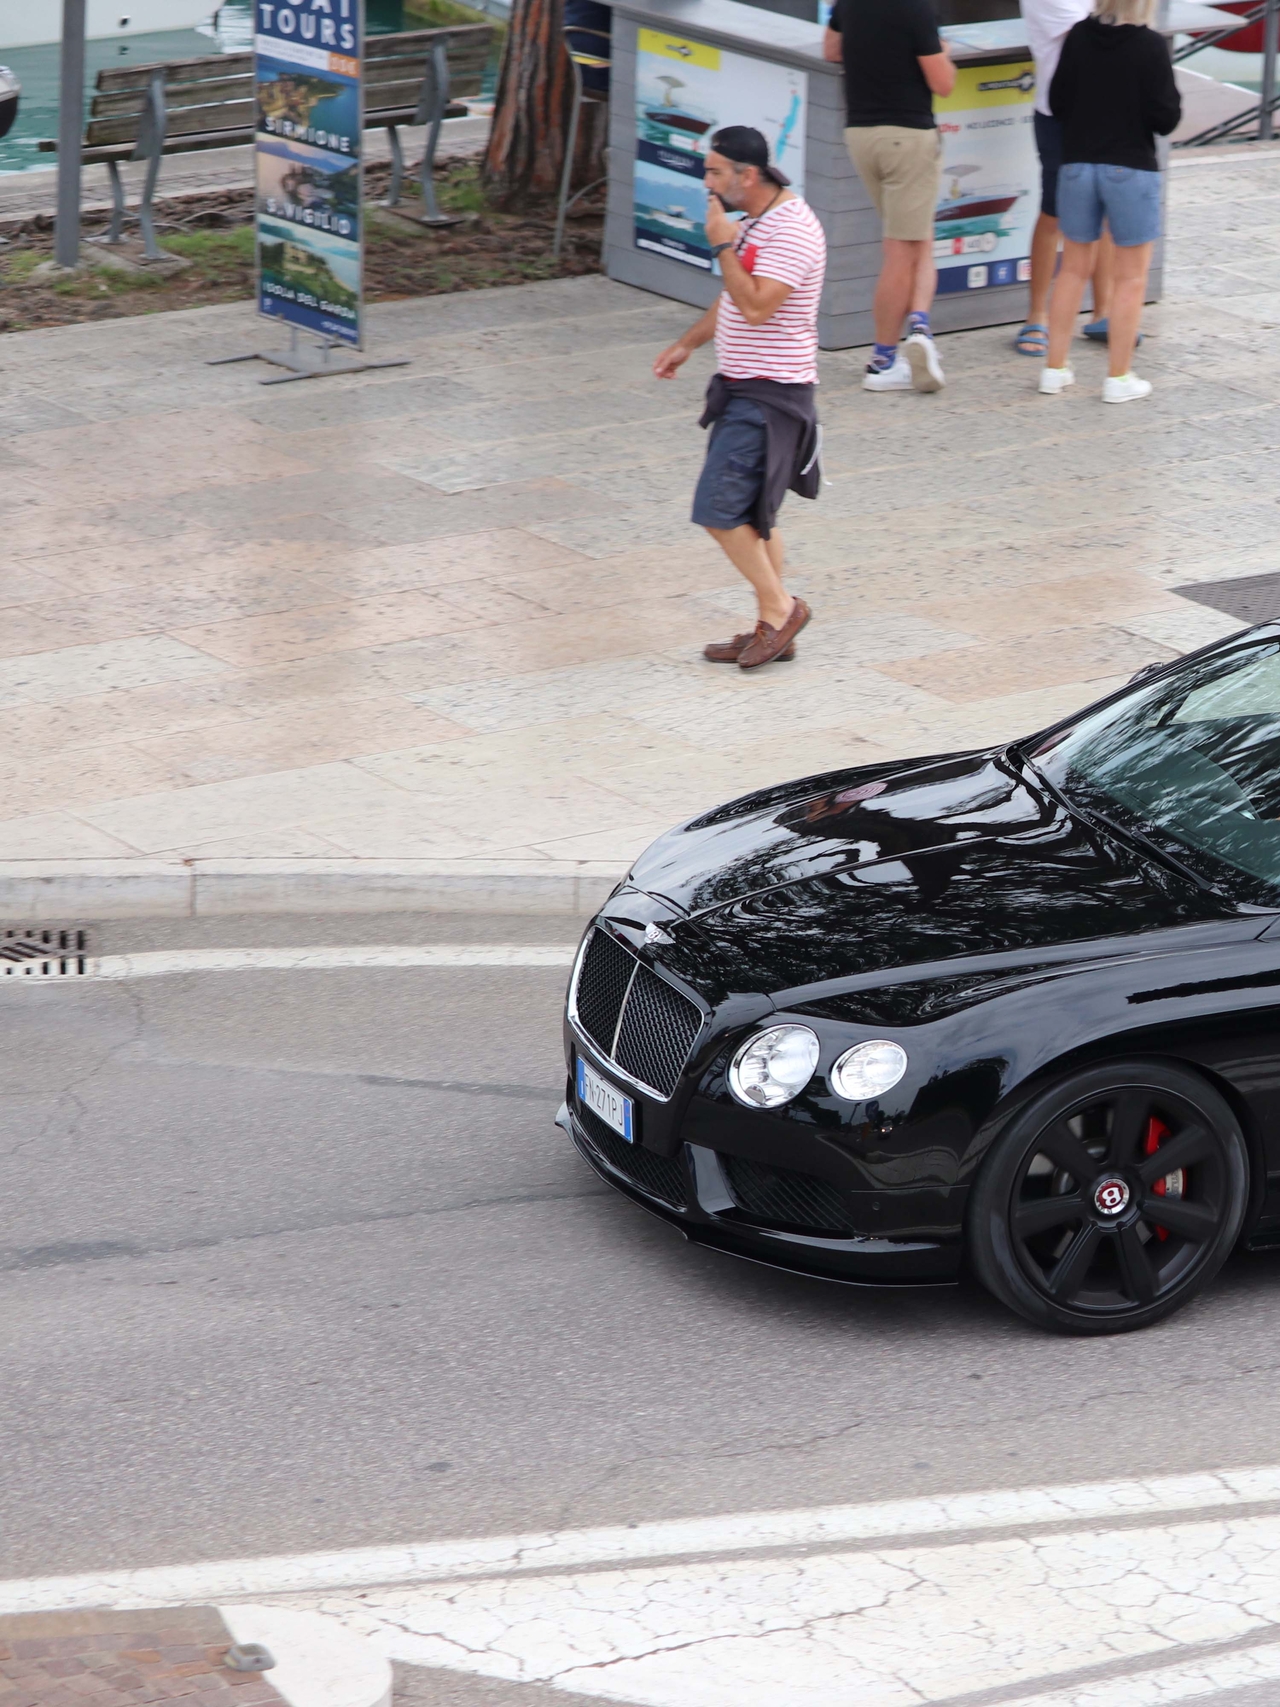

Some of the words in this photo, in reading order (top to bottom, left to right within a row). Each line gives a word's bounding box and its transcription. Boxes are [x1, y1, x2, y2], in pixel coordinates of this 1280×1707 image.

[259, 3, 354, 49] TOURS
[265, 116, 350, 152] SIRMIONE
[1101, 1186, 1122, 1206] B
